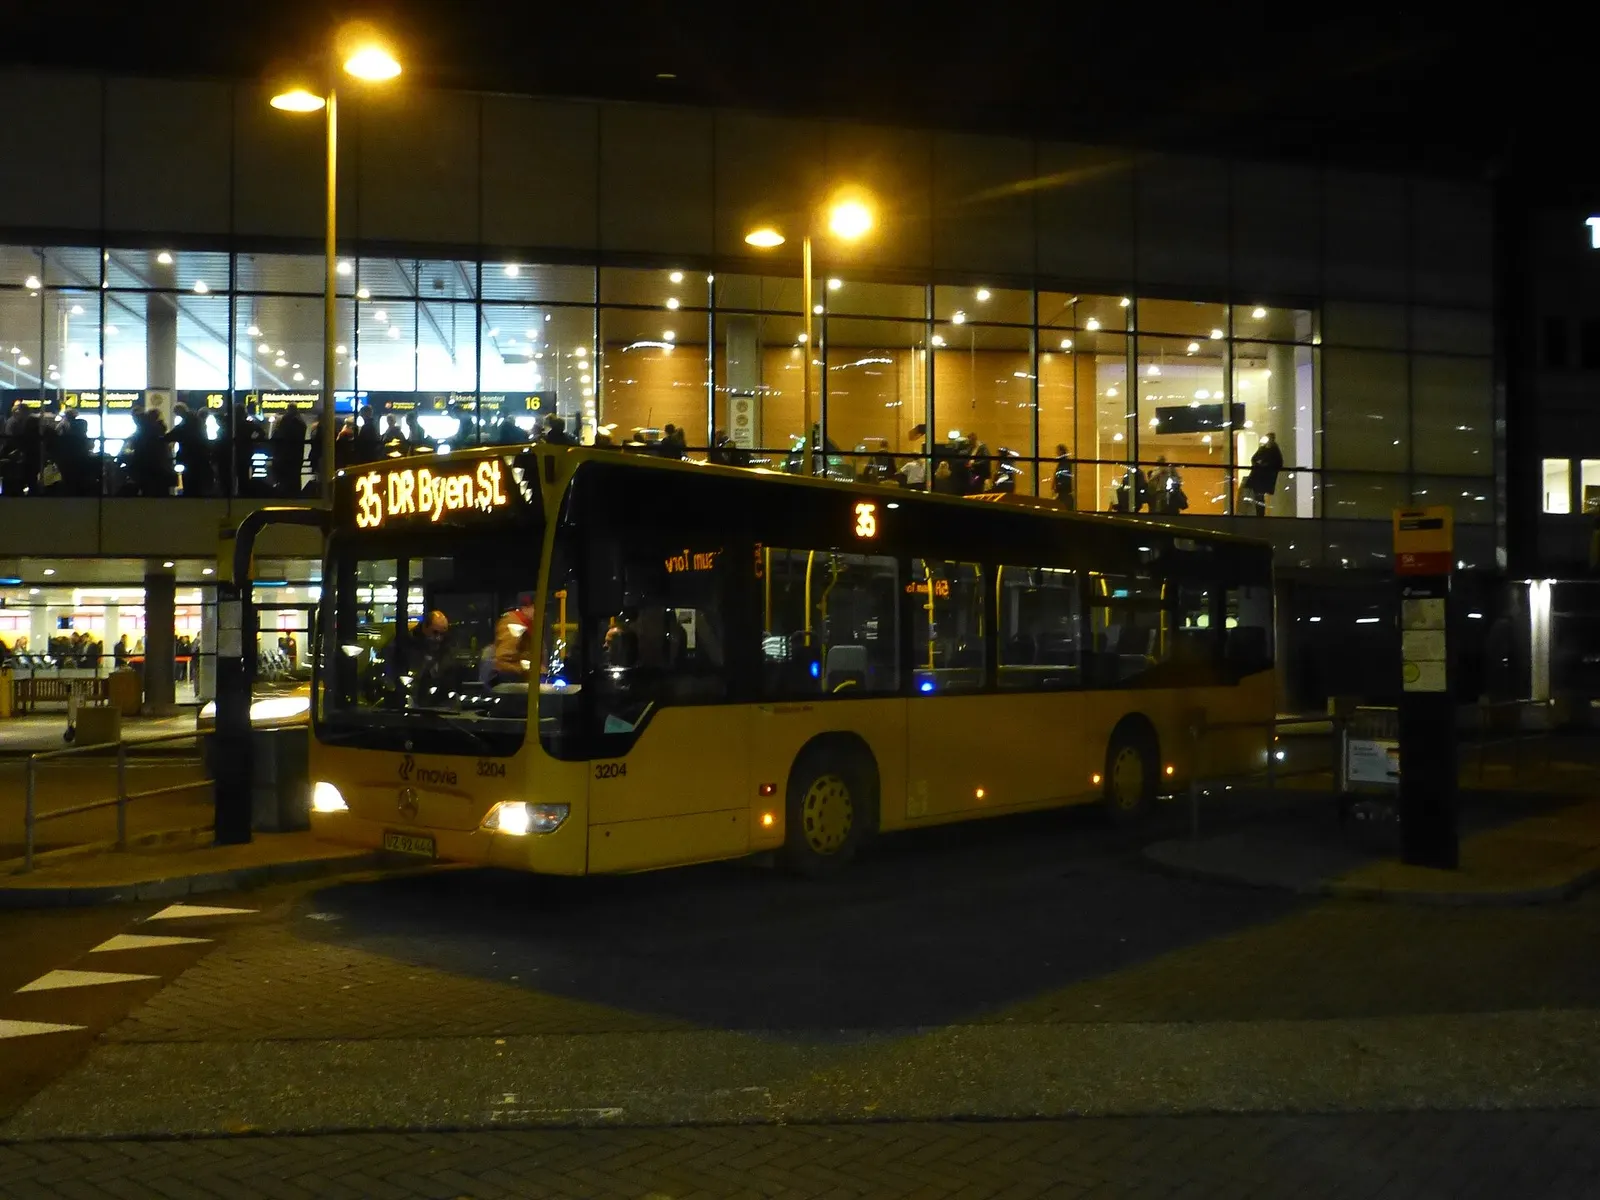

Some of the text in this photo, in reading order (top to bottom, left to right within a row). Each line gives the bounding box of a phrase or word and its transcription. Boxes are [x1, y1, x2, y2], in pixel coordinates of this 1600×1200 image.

[207, 394, 223, 409] 15
[525, 396, 541, 410] 16
[355, 470, 382, 528] 35
[387, 469, 415, 515] DR
[418, 468, 473, 522] Byen
[855, 503, 876, 537] 35
[416, 766, 457, 785] movia
[476, 760, 506, 778] 3204
[595, 762, 627, 779] 3204
